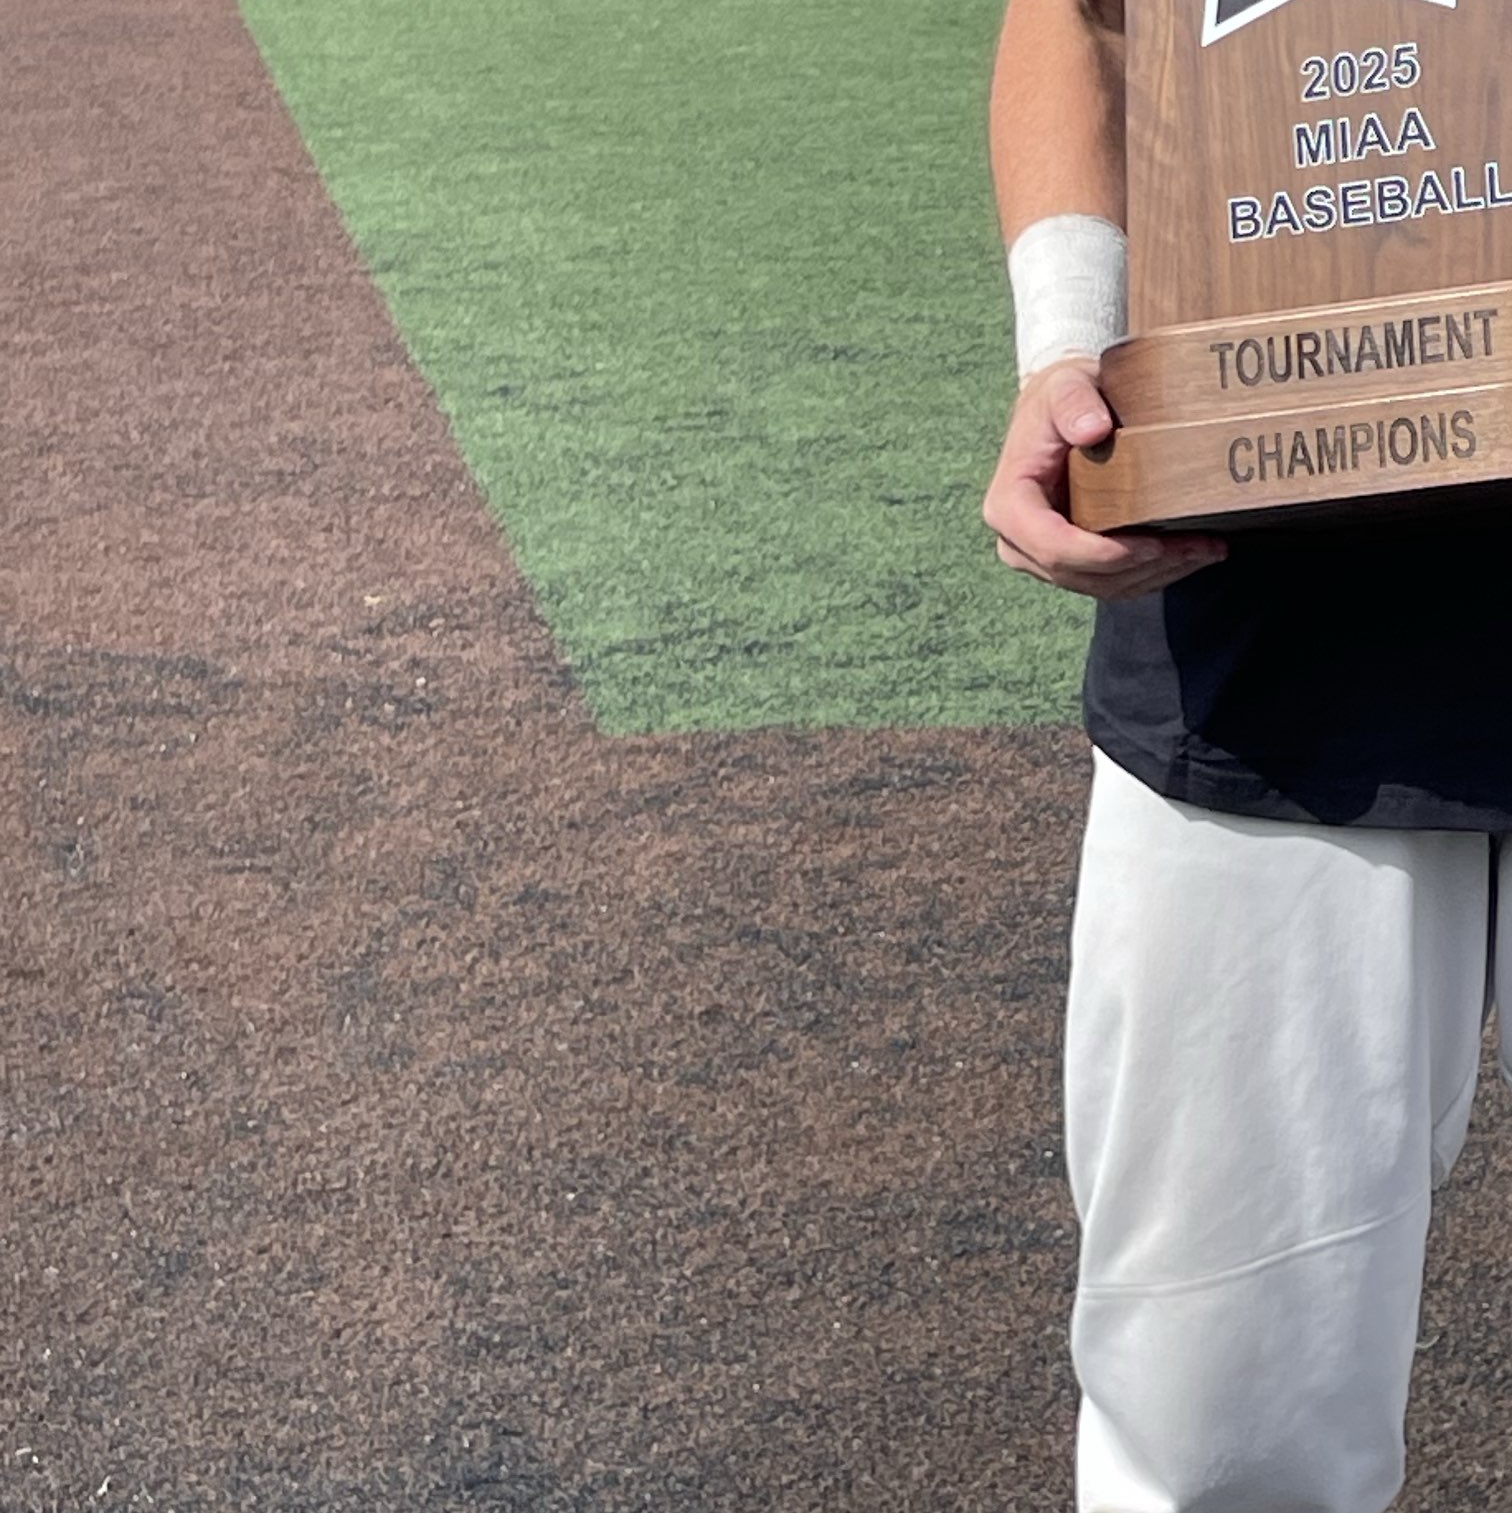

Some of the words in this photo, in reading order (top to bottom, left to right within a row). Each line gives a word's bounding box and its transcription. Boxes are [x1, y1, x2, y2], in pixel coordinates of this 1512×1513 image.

[1300, 42, 1421, 102] 2025
[1293, 107, 1436, 169] MIAA
[1209, 308, 1498, 389] TOURNAMENT
[1228, 410, 1477, 483] CHAMPIONS
